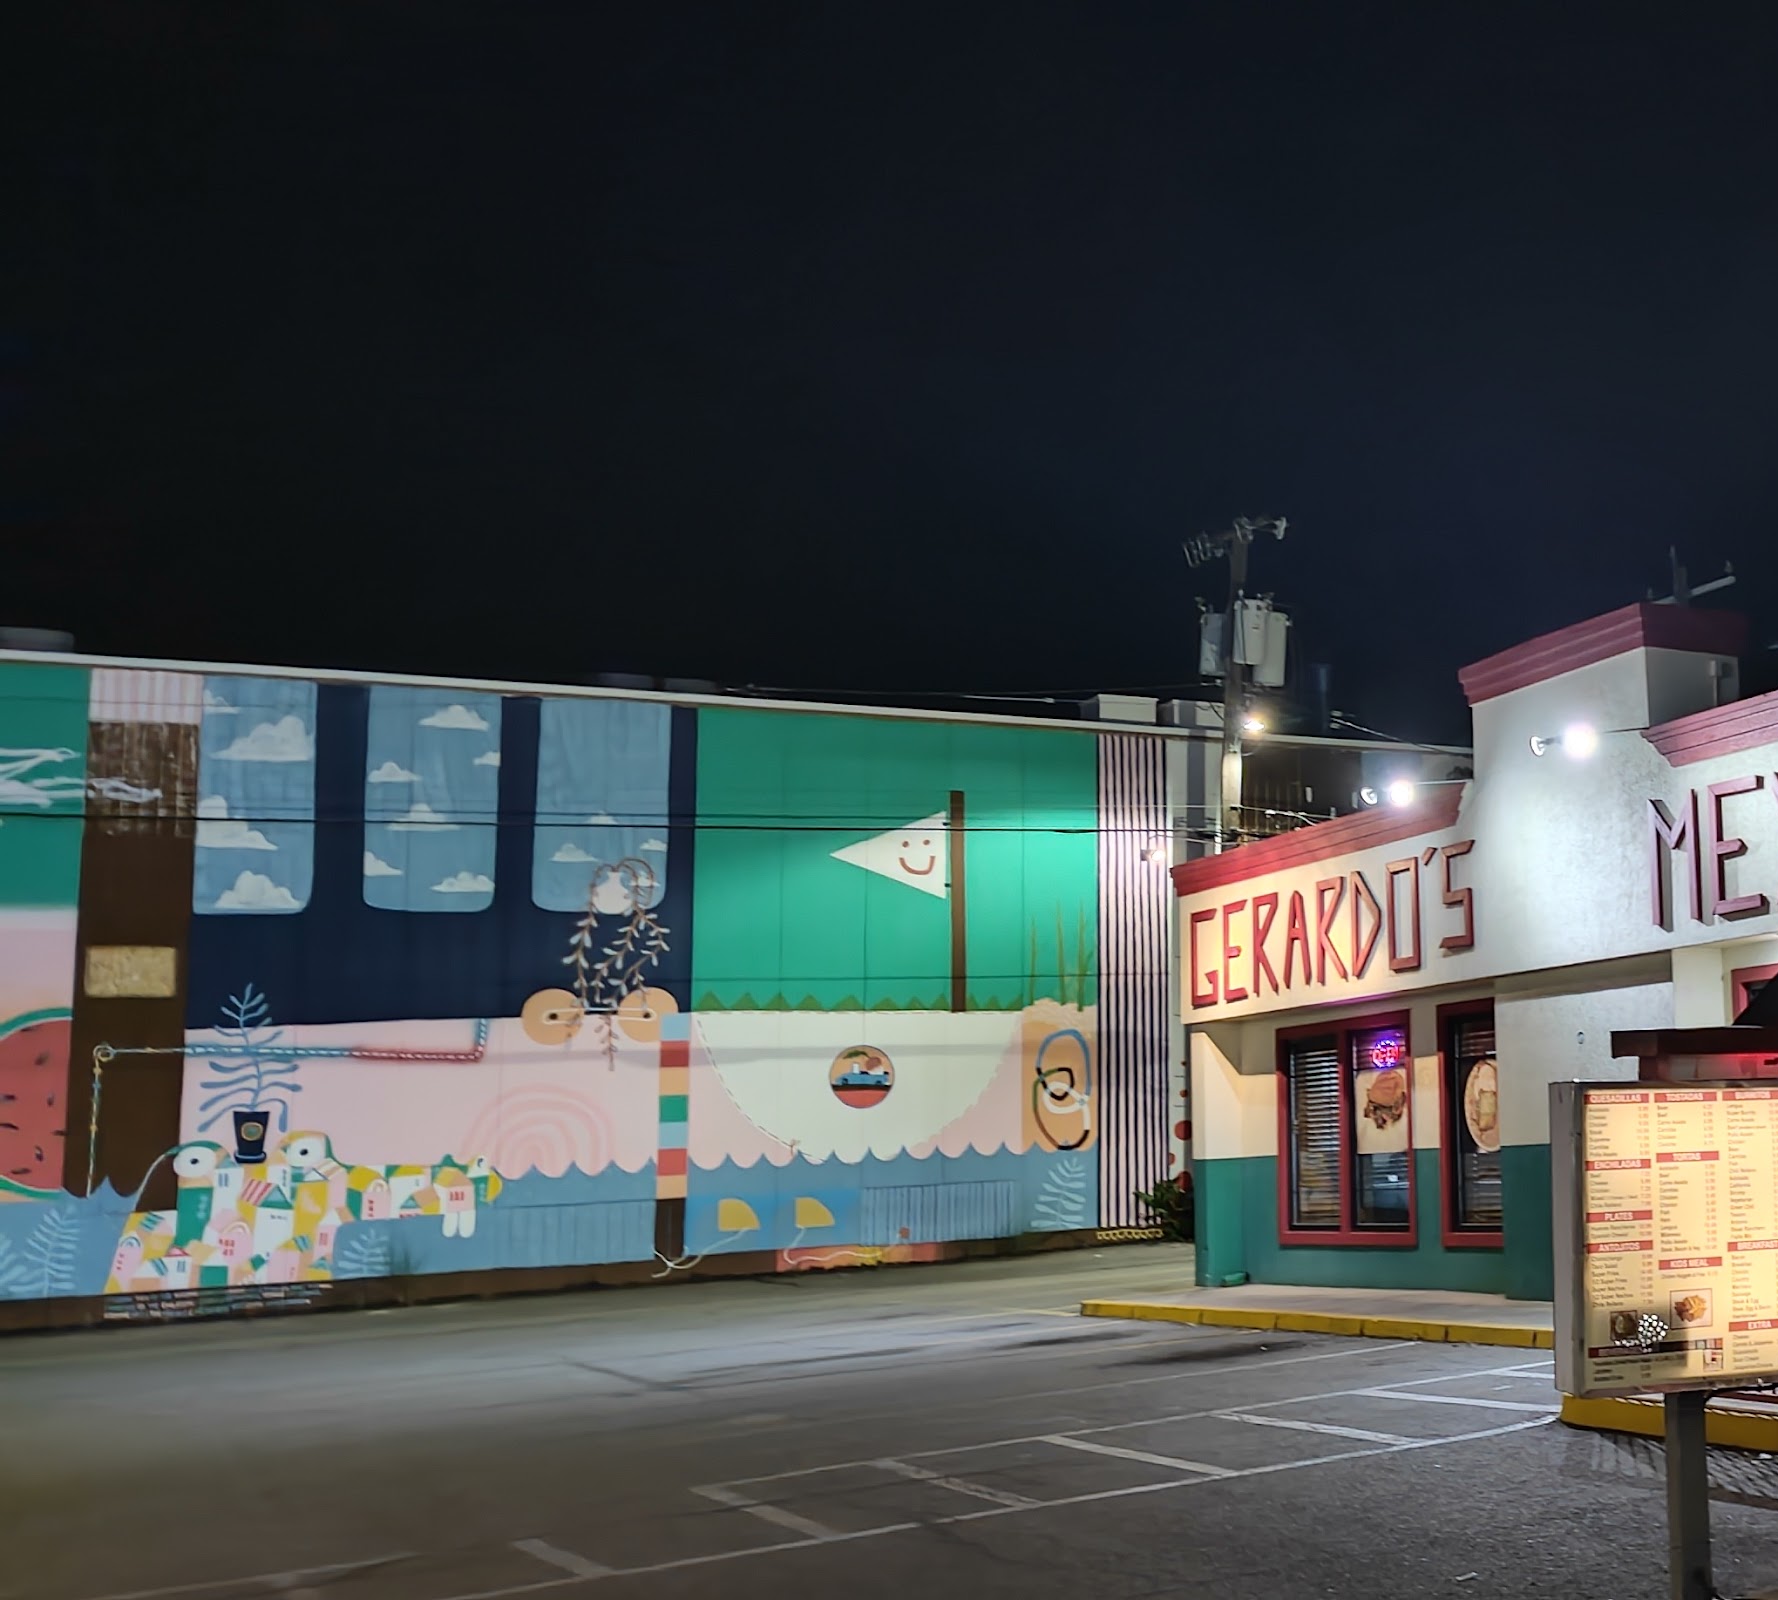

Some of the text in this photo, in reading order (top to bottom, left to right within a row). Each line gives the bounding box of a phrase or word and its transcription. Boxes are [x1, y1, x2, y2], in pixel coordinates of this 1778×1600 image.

[1190, 839, 1476, 1010] GERARDO'S
[1589, 1094, 1641, 1103] QUESADILLAS
[1665, 1092, 1703, 1101] TOSTADAS
[1594, 1160, 1641, 1169] ENCHILADAS
[1605, 1212, 1633, 1220] PLATES
[1598, 1242, 1640, 1252] ANTOJITOS
[1737, 1240, 1778, 1250] BREAKFAST
[1670, 1259, 1709, 1268] KIDS MEAL
[1748, 1321, 1772, 1329] EXTRA
